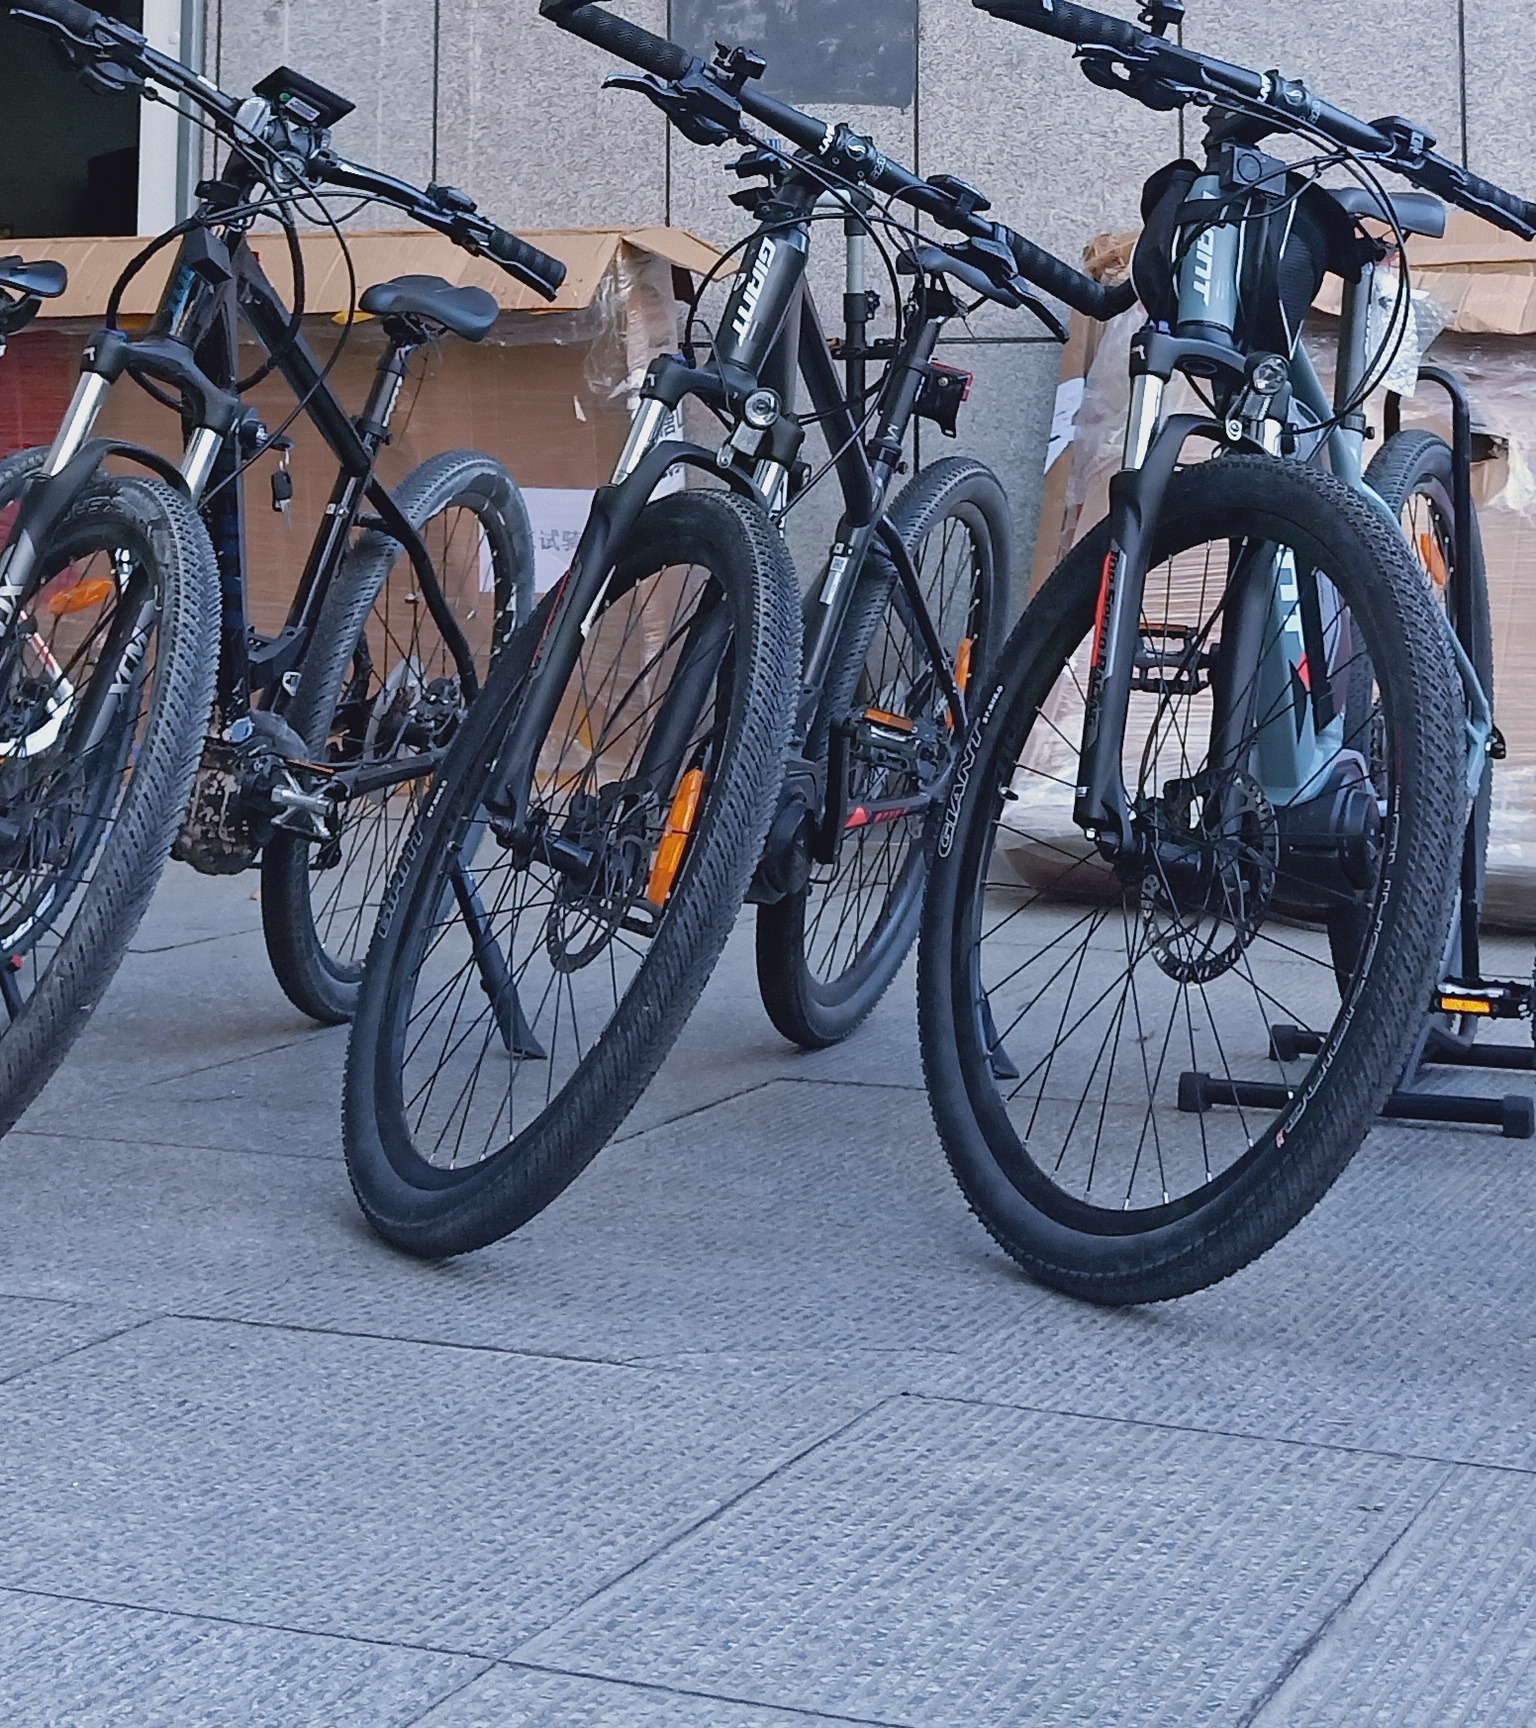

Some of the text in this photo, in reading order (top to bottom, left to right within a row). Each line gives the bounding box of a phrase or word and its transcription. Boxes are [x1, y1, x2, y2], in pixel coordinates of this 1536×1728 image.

[731, 236, 776, 347] GIANT
[108, 626, 148, 710] XCM
[938, 717, 982, 858] GIANT
